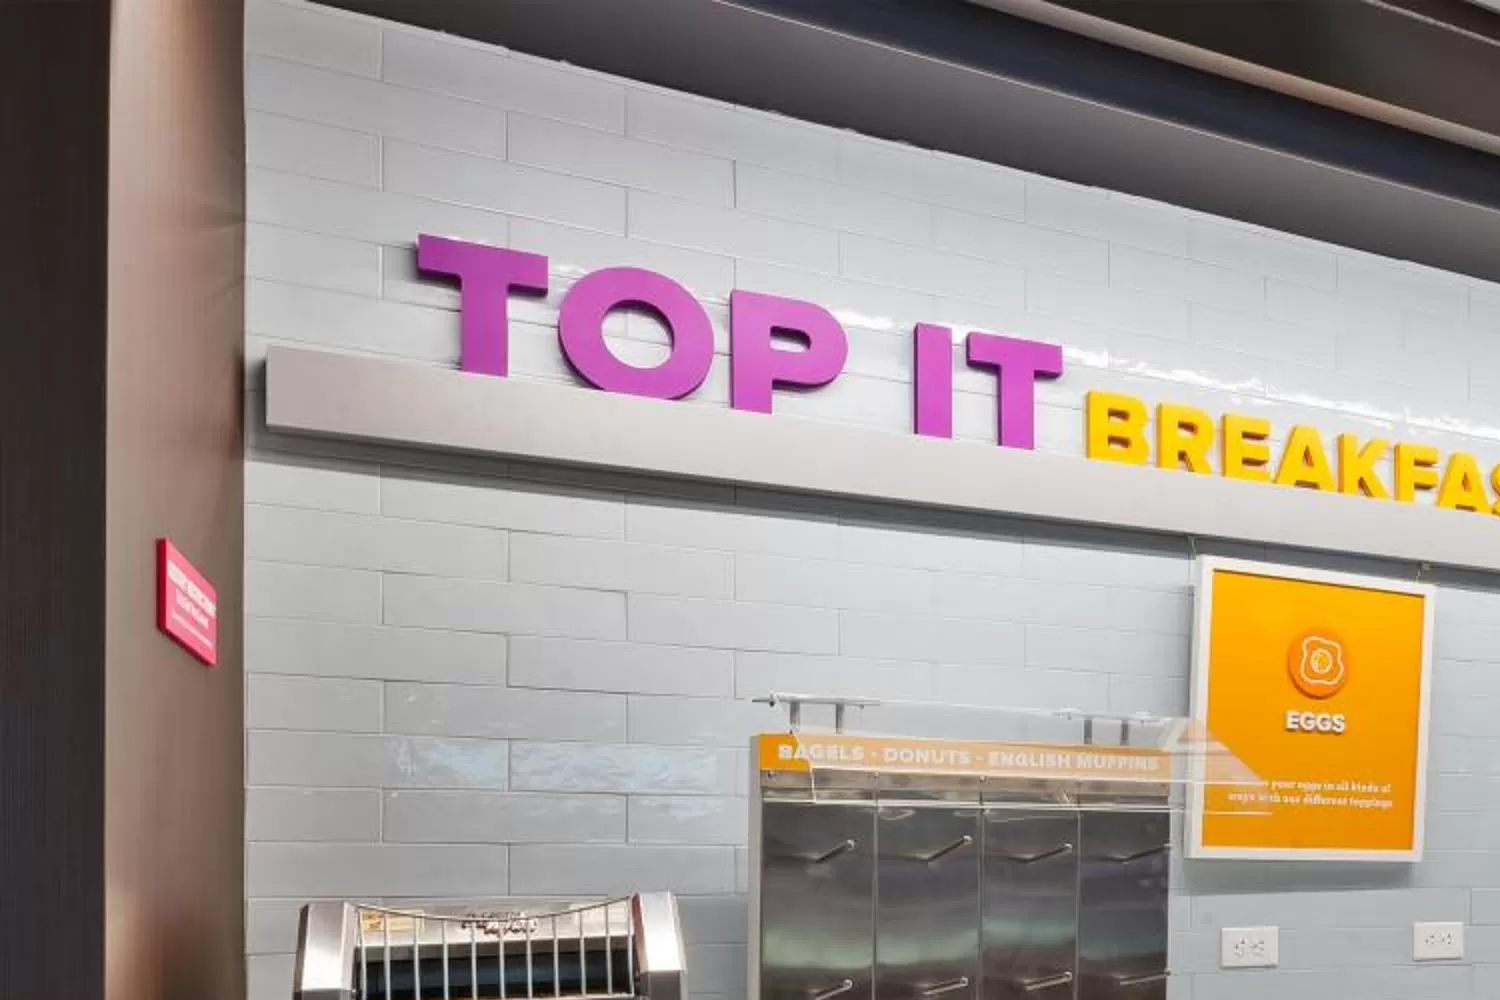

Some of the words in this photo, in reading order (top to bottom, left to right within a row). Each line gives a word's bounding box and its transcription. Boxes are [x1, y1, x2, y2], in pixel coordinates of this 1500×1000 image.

[416, 232, 848, 414] TOP
[913, 322, 1063, 450] IT
[1286, 710, 1345, 733] EGGS
[777, 743, 865, 761] BAGELS
[883, 746, 972, 765] DONUTS
[988, 751, 1071, 768] ENGLISH
[1077, 754, 1159, 771] MUFFINS
